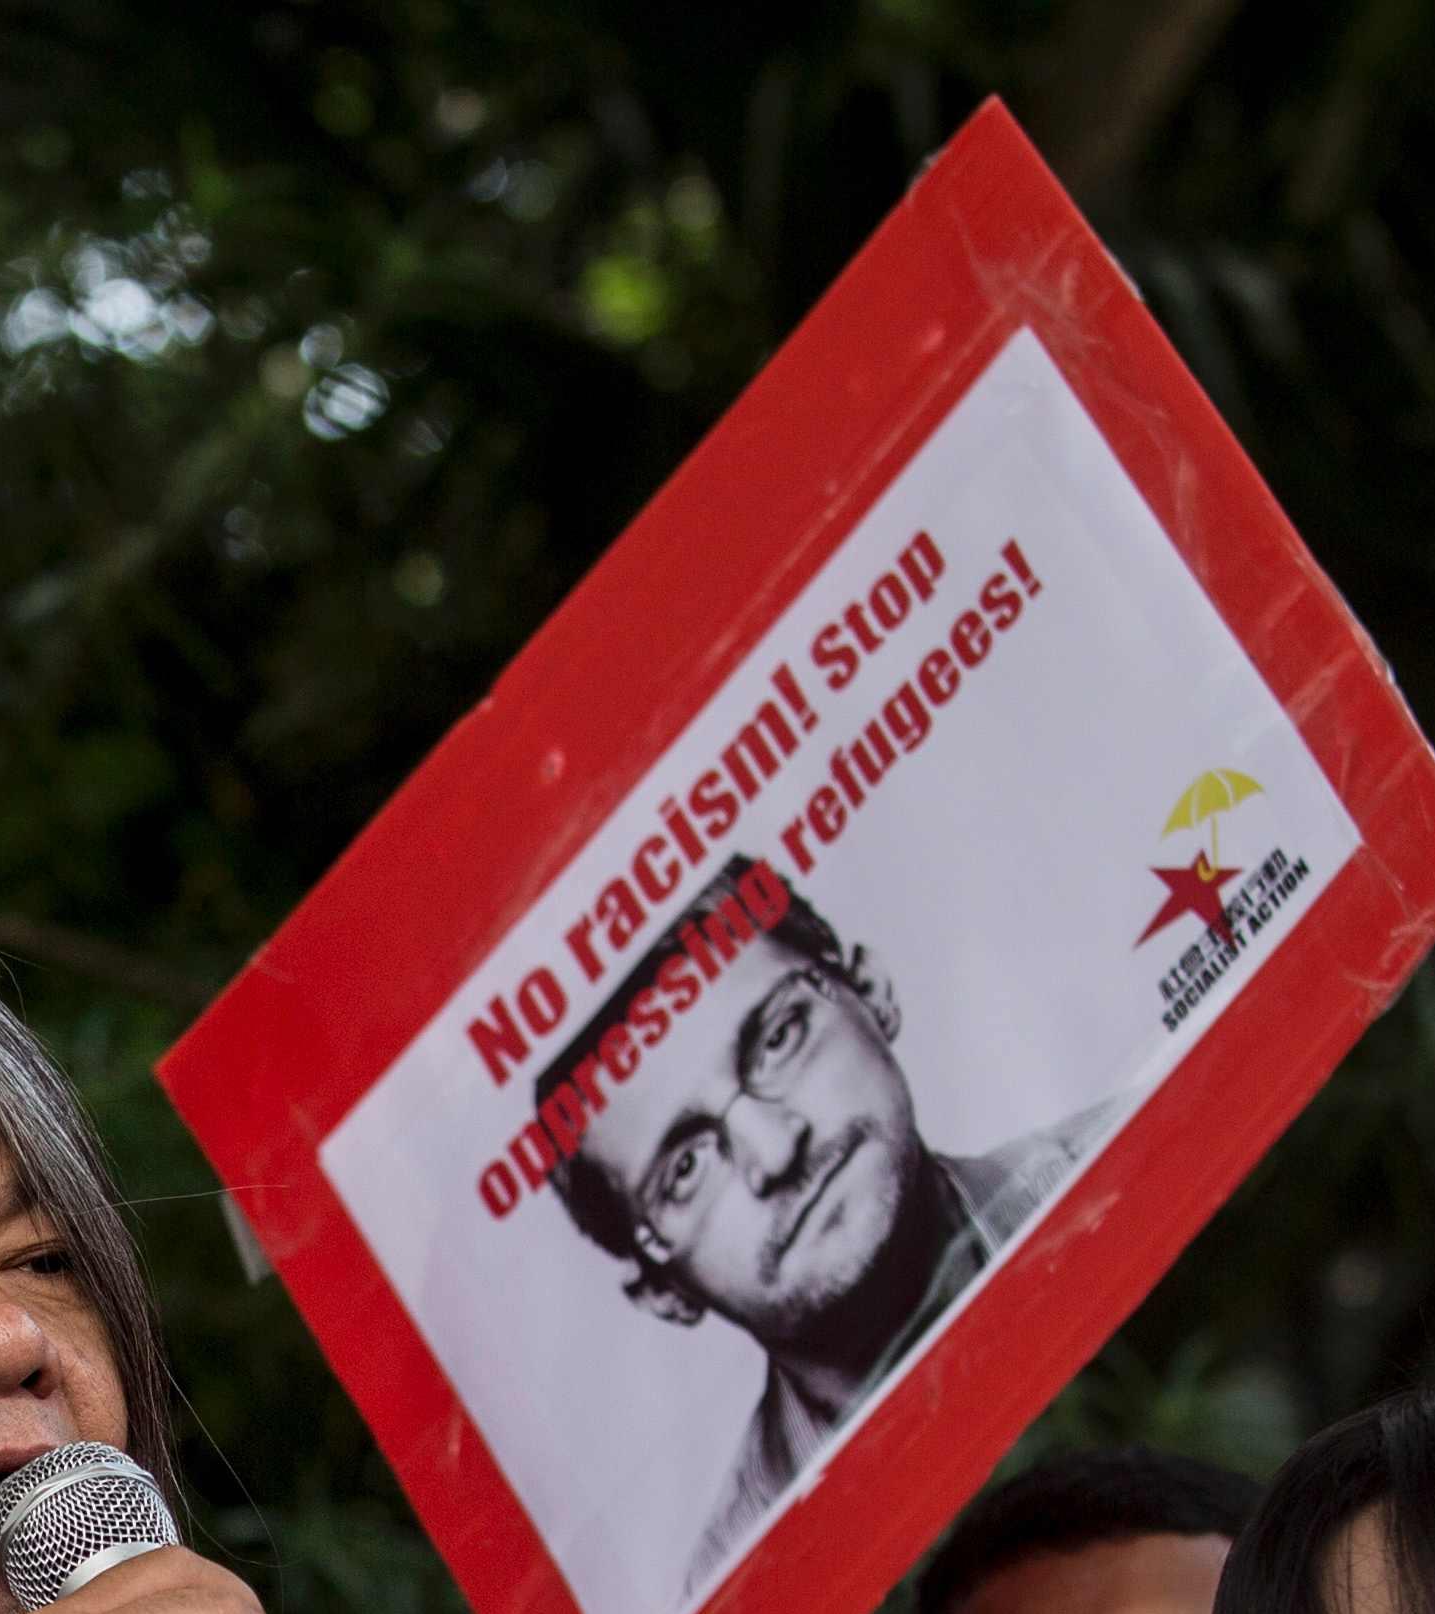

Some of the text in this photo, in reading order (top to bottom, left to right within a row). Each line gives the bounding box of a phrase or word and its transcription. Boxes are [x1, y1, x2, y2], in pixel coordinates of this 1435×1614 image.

[465, 528, 950, 1089] No racism! Stop
[780, 537, 1047, 875] refugees!
[1160, 855, 1310, 1034] SOCIALIST ACTION
